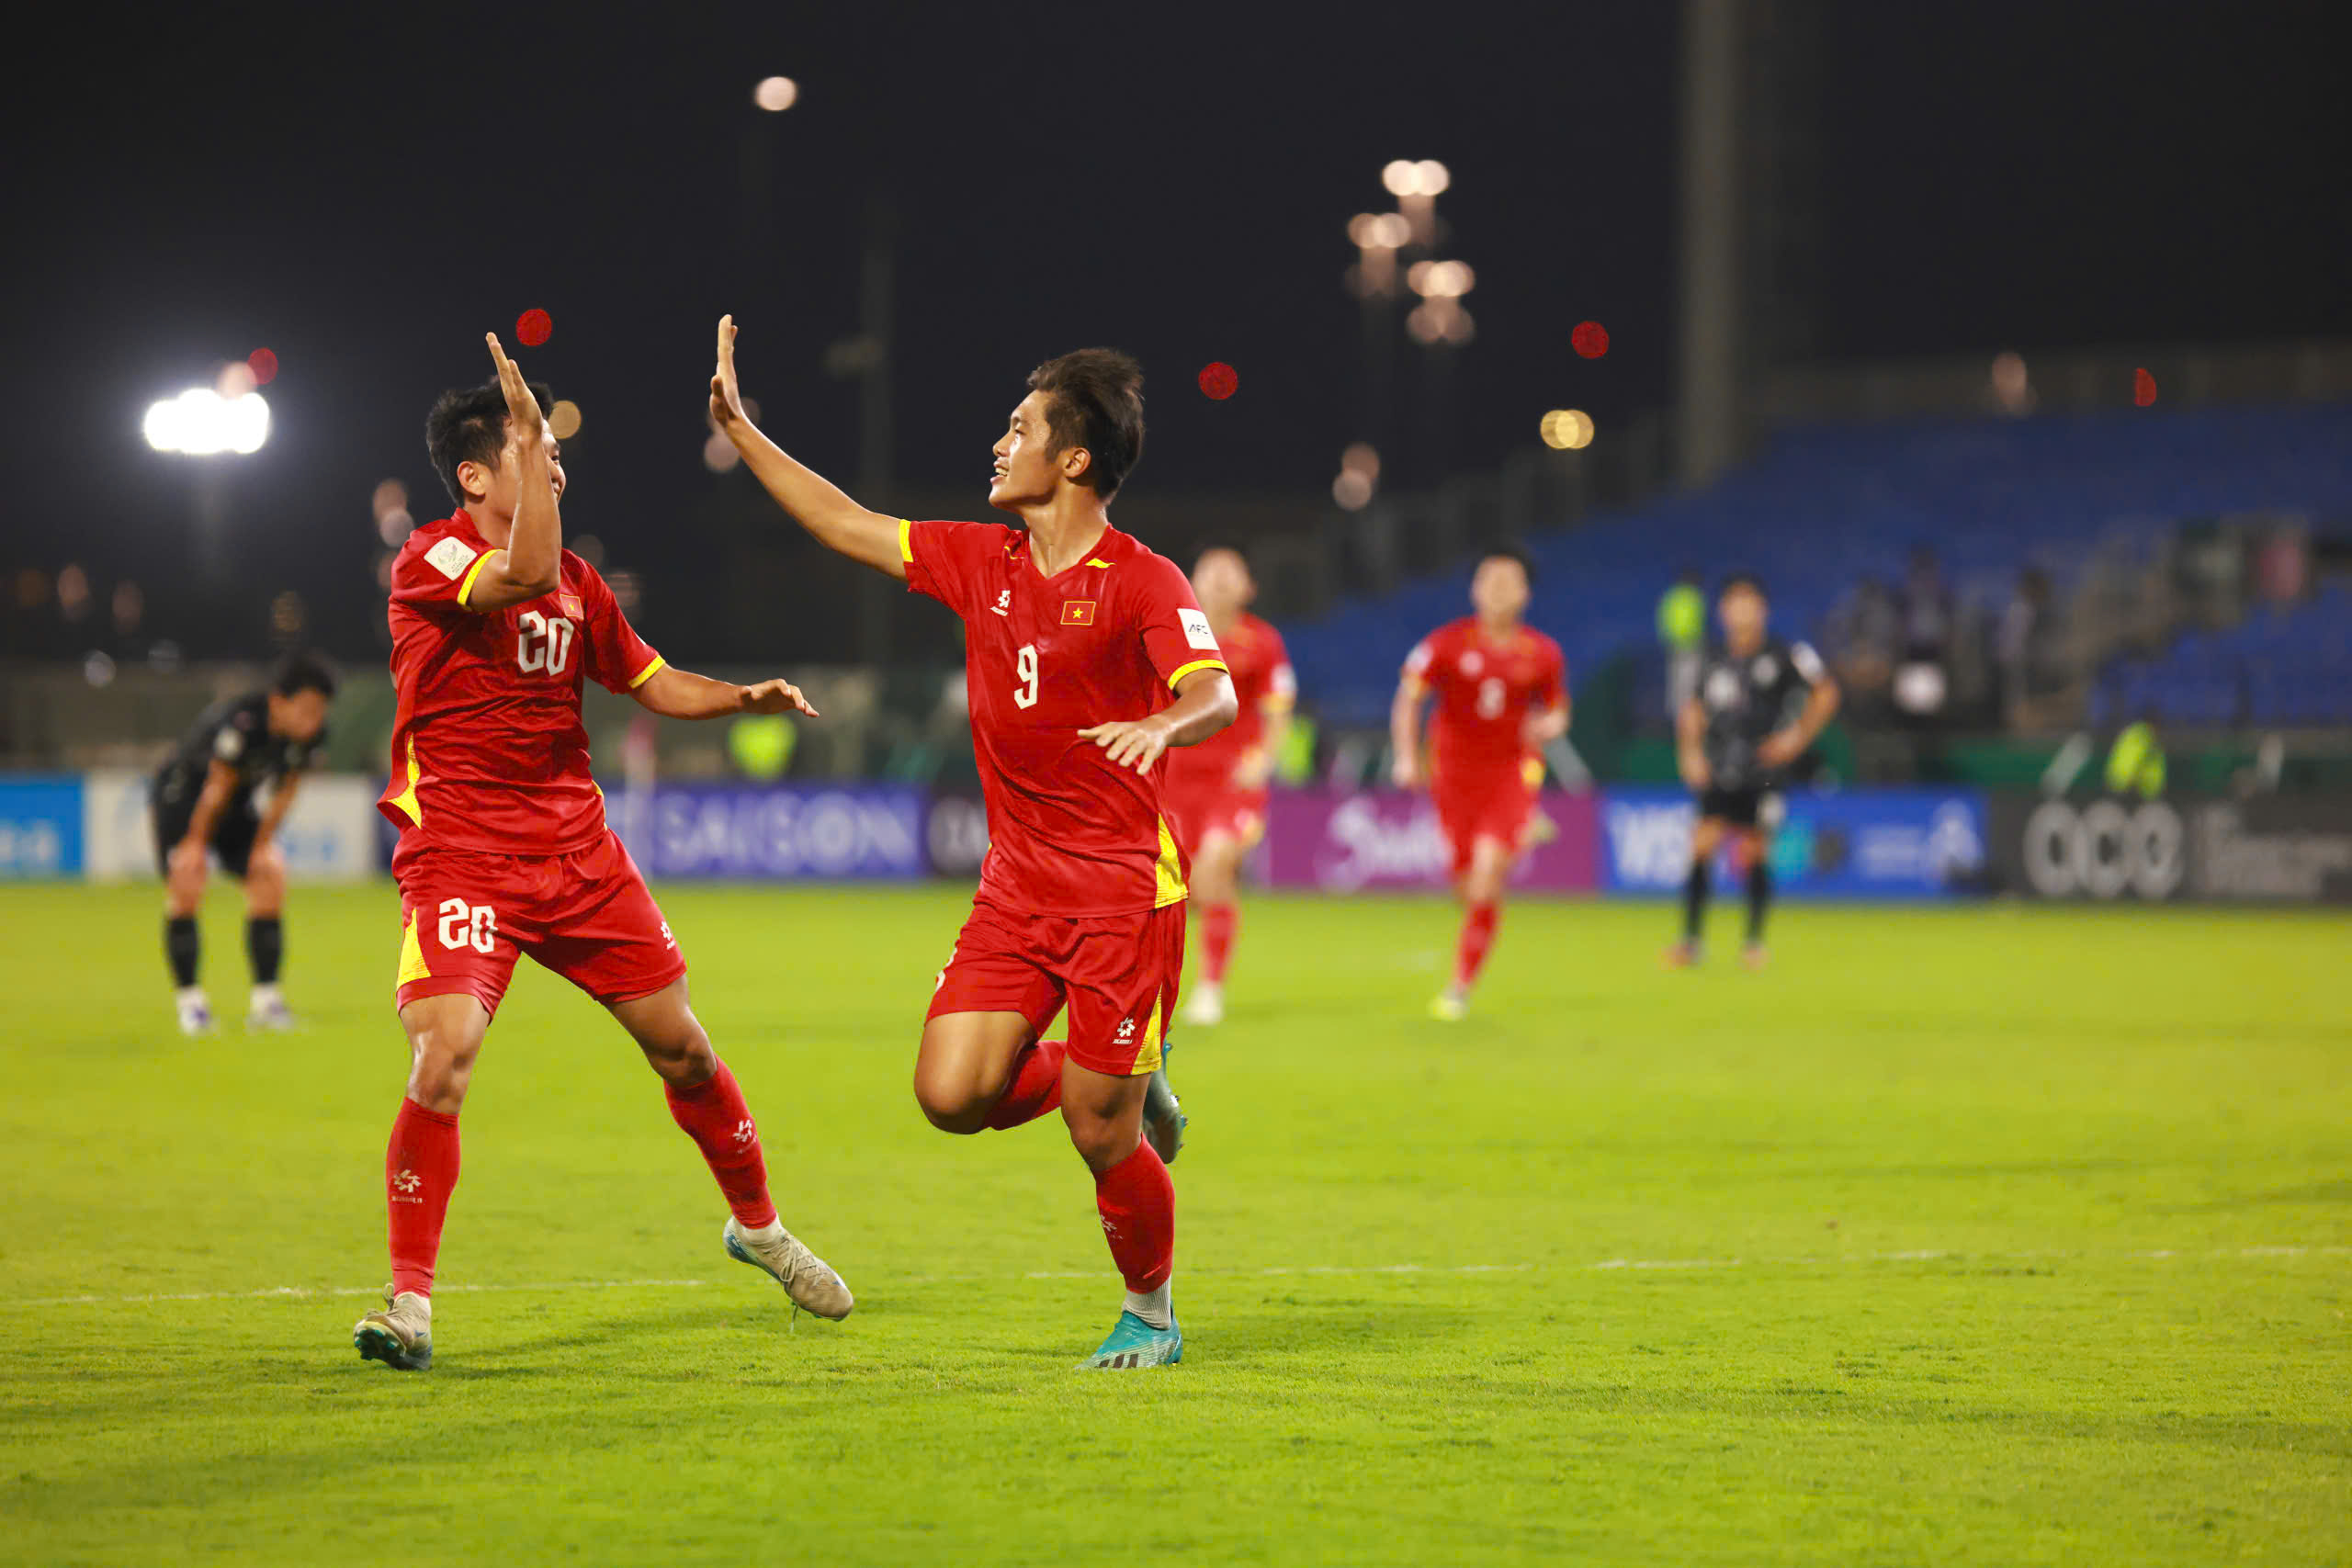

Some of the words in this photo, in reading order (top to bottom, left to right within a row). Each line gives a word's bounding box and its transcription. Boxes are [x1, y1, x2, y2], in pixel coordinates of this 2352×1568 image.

[517, 610, 574, 676] 20
[1013, 645, 1039, 710] 9
[438, 897, 499, 953] 20
